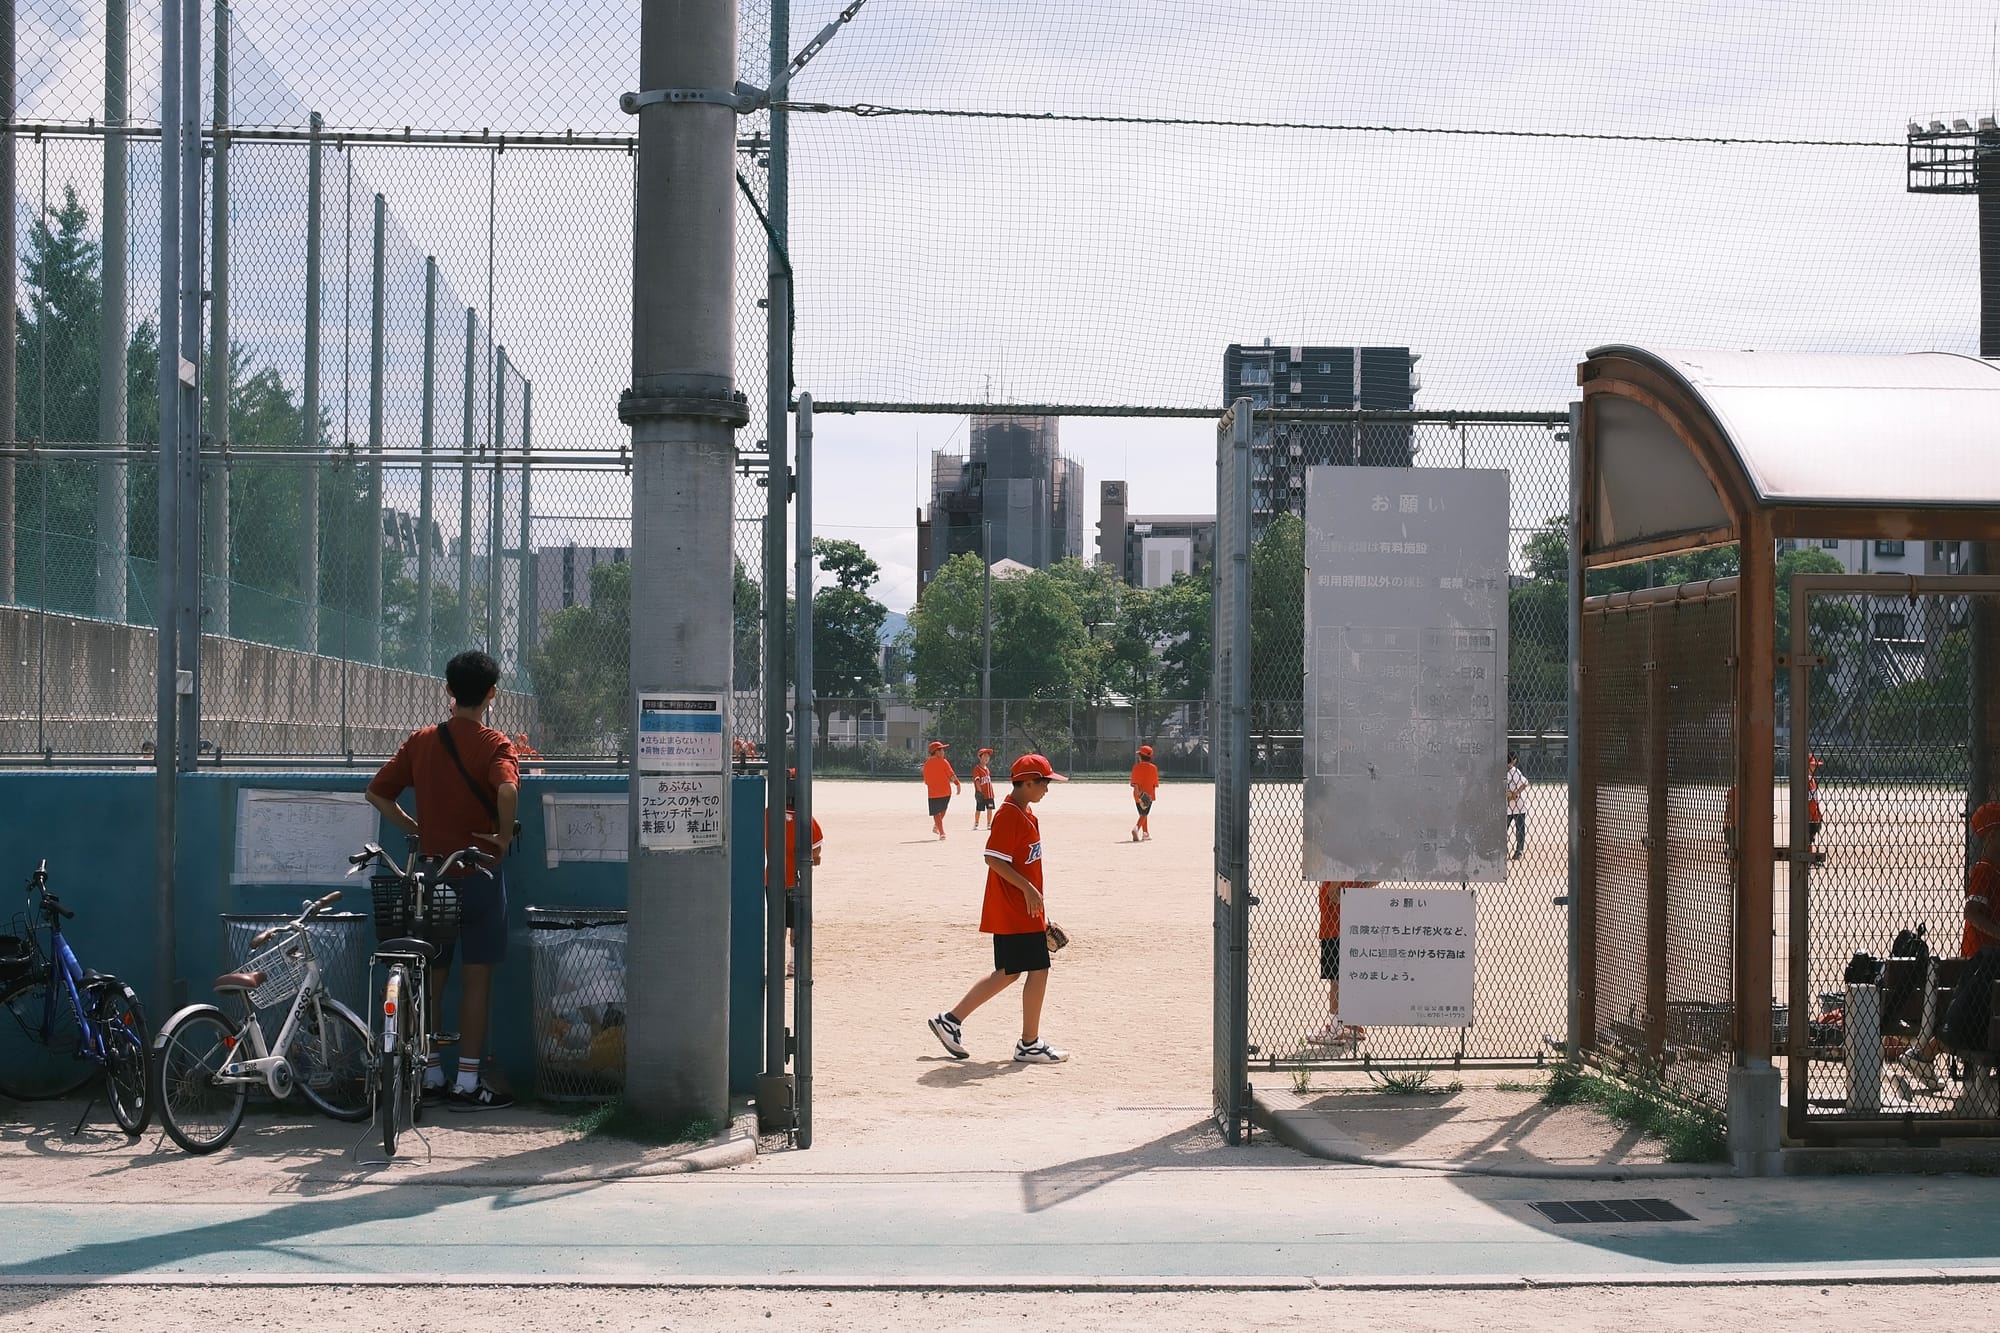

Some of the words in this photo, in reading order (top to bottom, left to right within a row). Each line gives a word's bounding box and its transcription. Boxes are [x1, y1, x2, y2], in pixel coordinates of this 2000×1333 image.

[1370, 494, 1446, 513] お願い
[658, 780, 702, 792] あぶない
[642, 796, 720, 806] フェンスの外での
[642, 820, 676, 834] 素振り
[1389, 897, 1427, 908] お願い
[1349, 925, 1469, 937] 危険な打ち上げ花火など、
[1349, 947, 1466, 960] 他人に迷惑をかける行為は
[1348, 971, 1415, 982] やめましょう。
[294, 986, 312, 1021] esse
[478, 1090, 493, 1103] N
